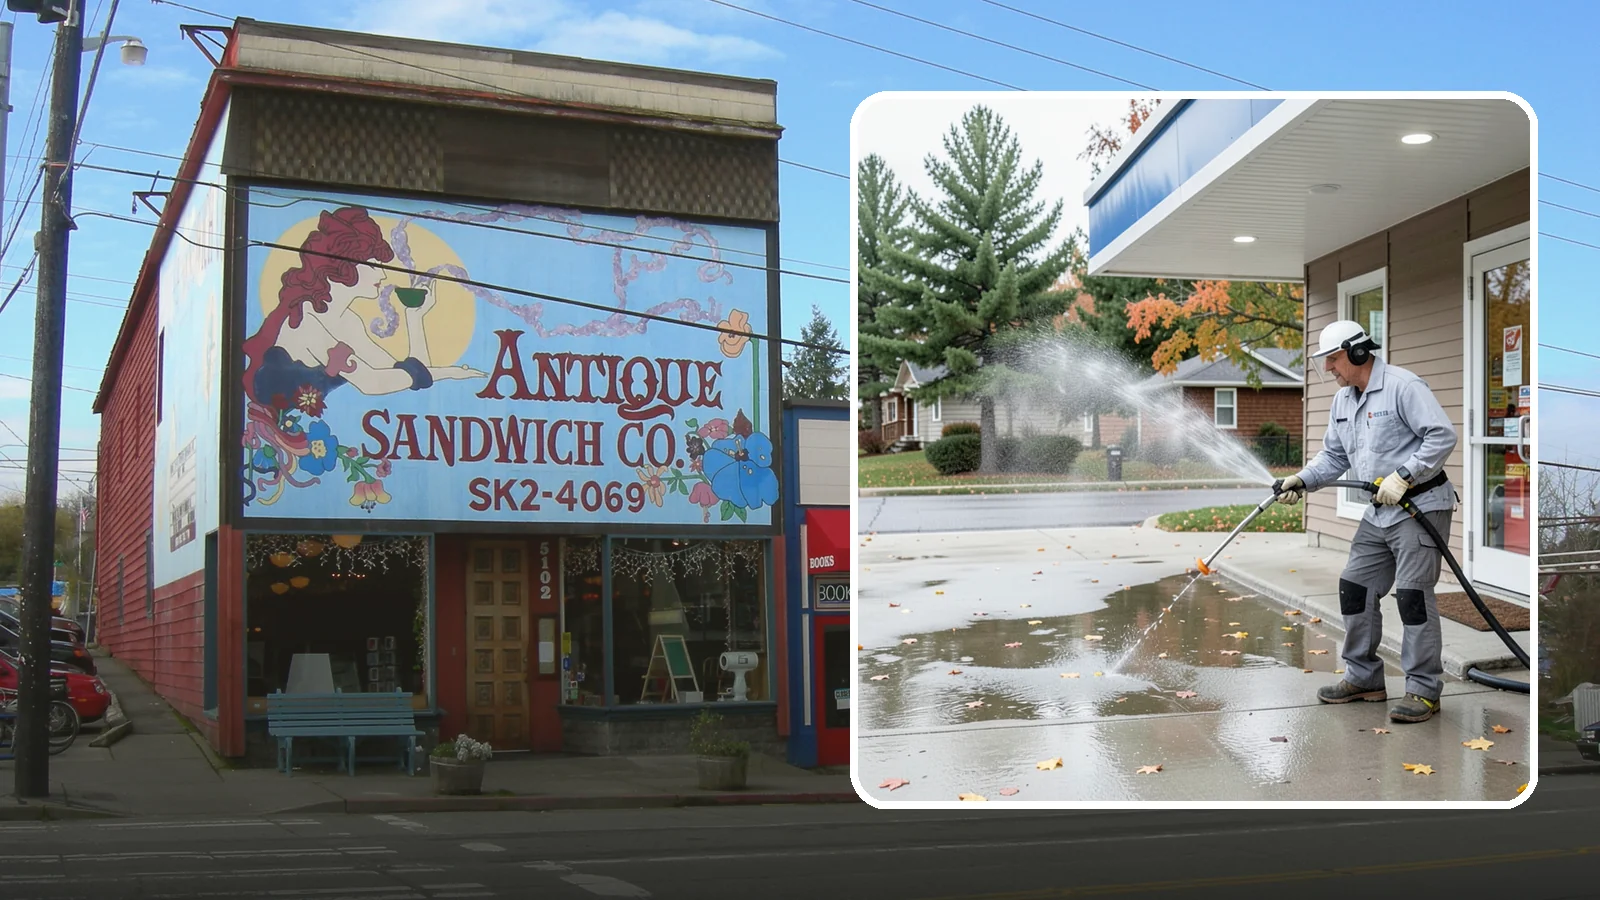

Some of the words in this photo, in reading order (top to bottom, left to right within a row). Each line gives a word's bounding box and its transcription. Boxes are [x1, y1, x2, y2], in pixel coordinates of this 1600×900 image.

[475, 329, 723, 420] ANTIQUE
[361, 408, 604, 467] SANDWICH
[617, 422, 685, 469] CO.
[468, 477, 646, 513] SK2-4069
[540, 541, 552, 600] 5102
[809, 555, 835, 569] BOOKS
